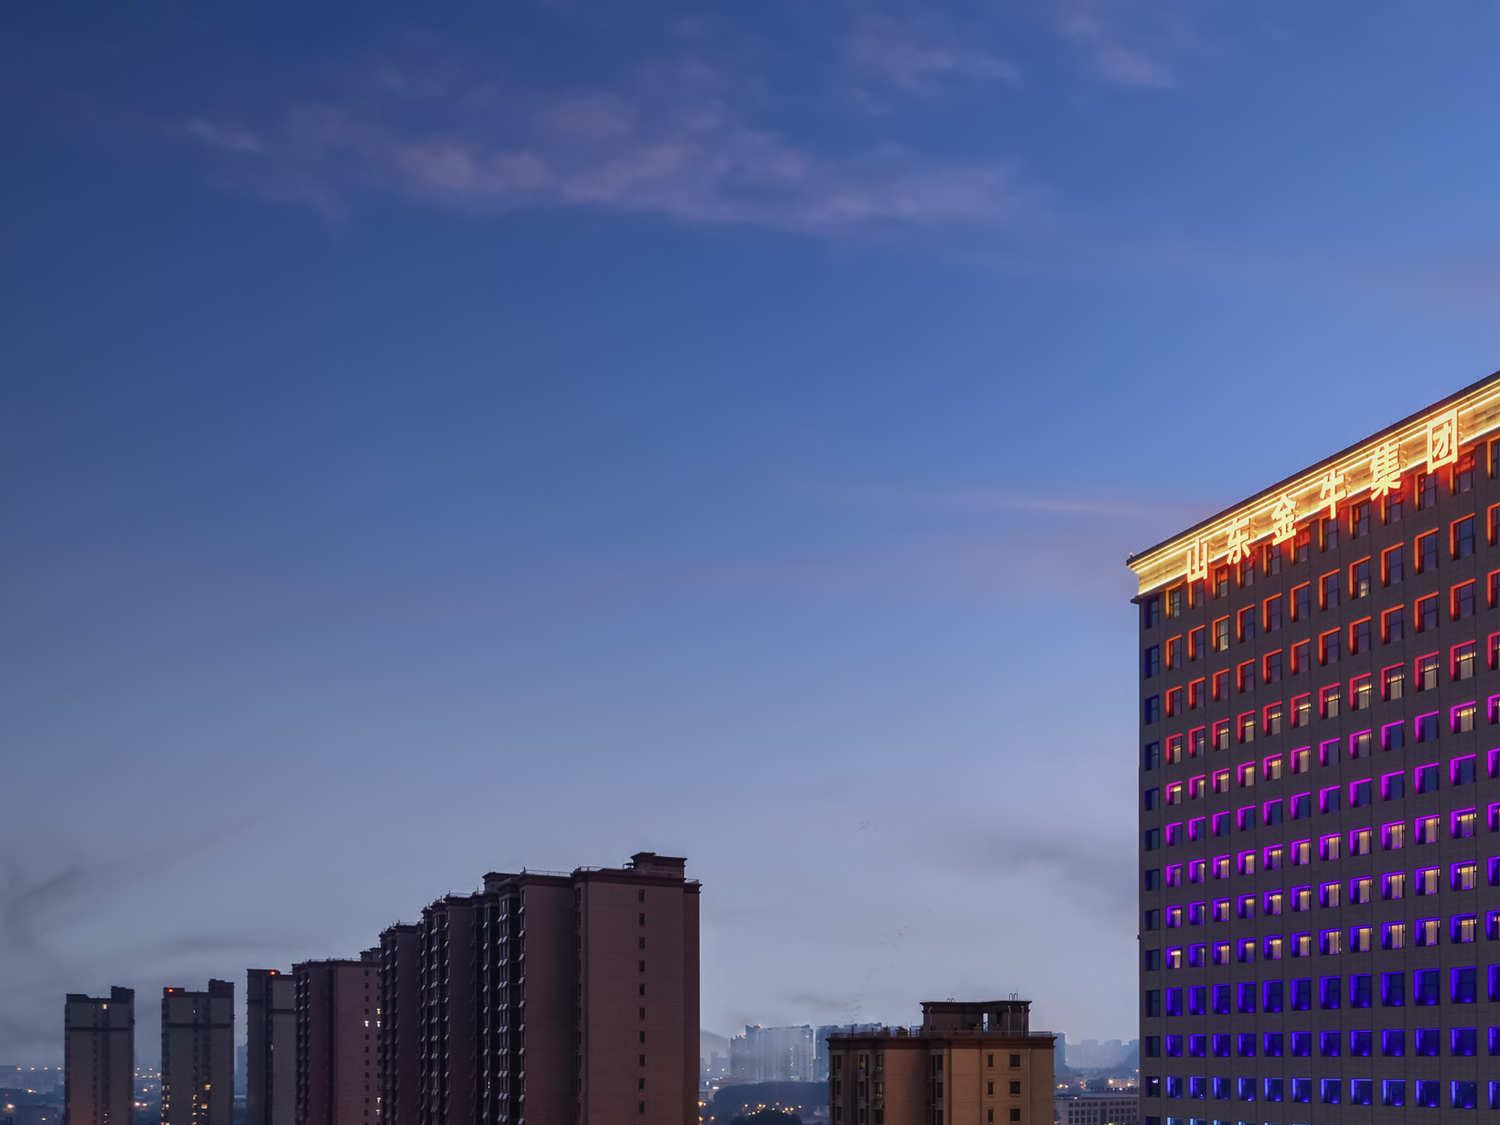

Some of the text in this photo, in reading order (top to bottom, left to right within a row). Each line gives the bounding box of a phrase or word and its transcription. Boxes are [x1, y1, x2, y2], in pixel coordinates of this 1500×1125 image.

[1186, 410, 1459, 583] 山东金牛集团
